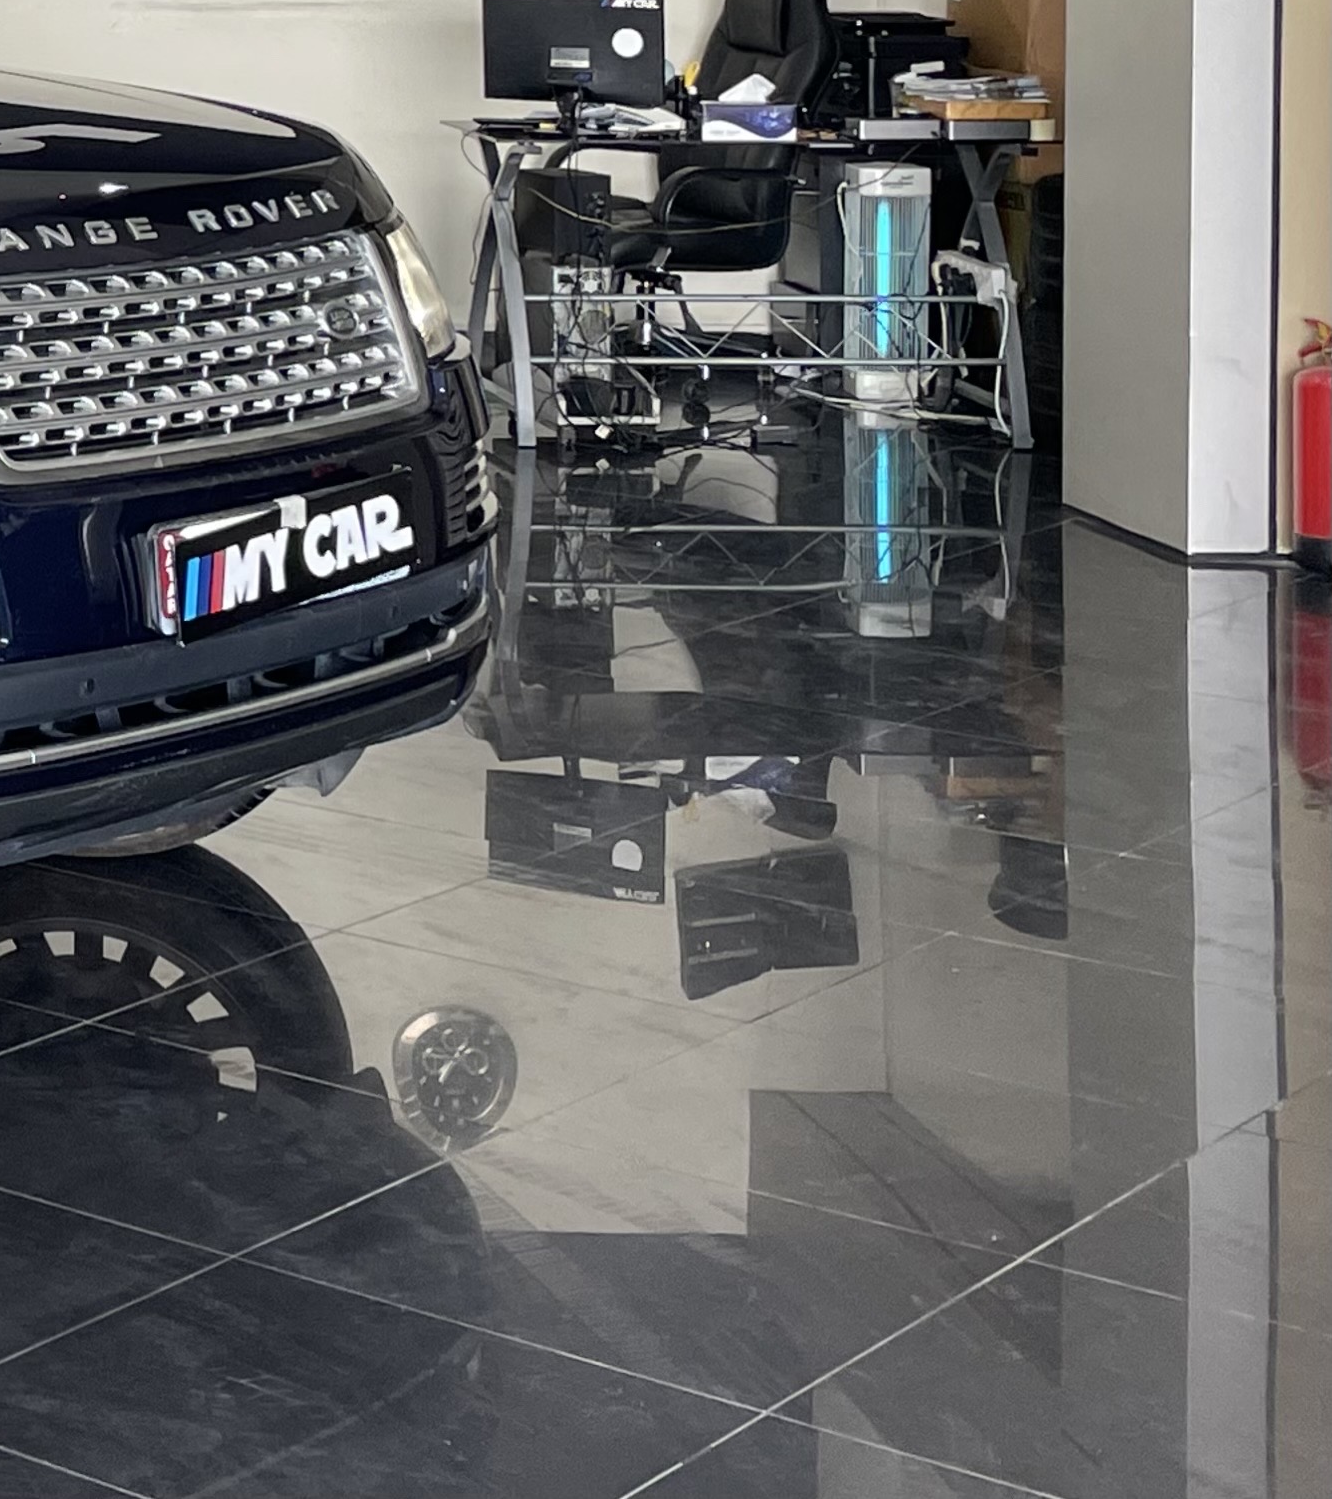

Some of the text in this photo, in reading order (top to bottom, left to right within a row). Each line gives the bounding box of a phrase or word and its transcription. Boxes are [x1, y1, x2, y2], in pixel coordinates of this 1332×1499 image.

[187, 189, 340, 234] ROVER
[222, 494, 414, 611] MY CAR
